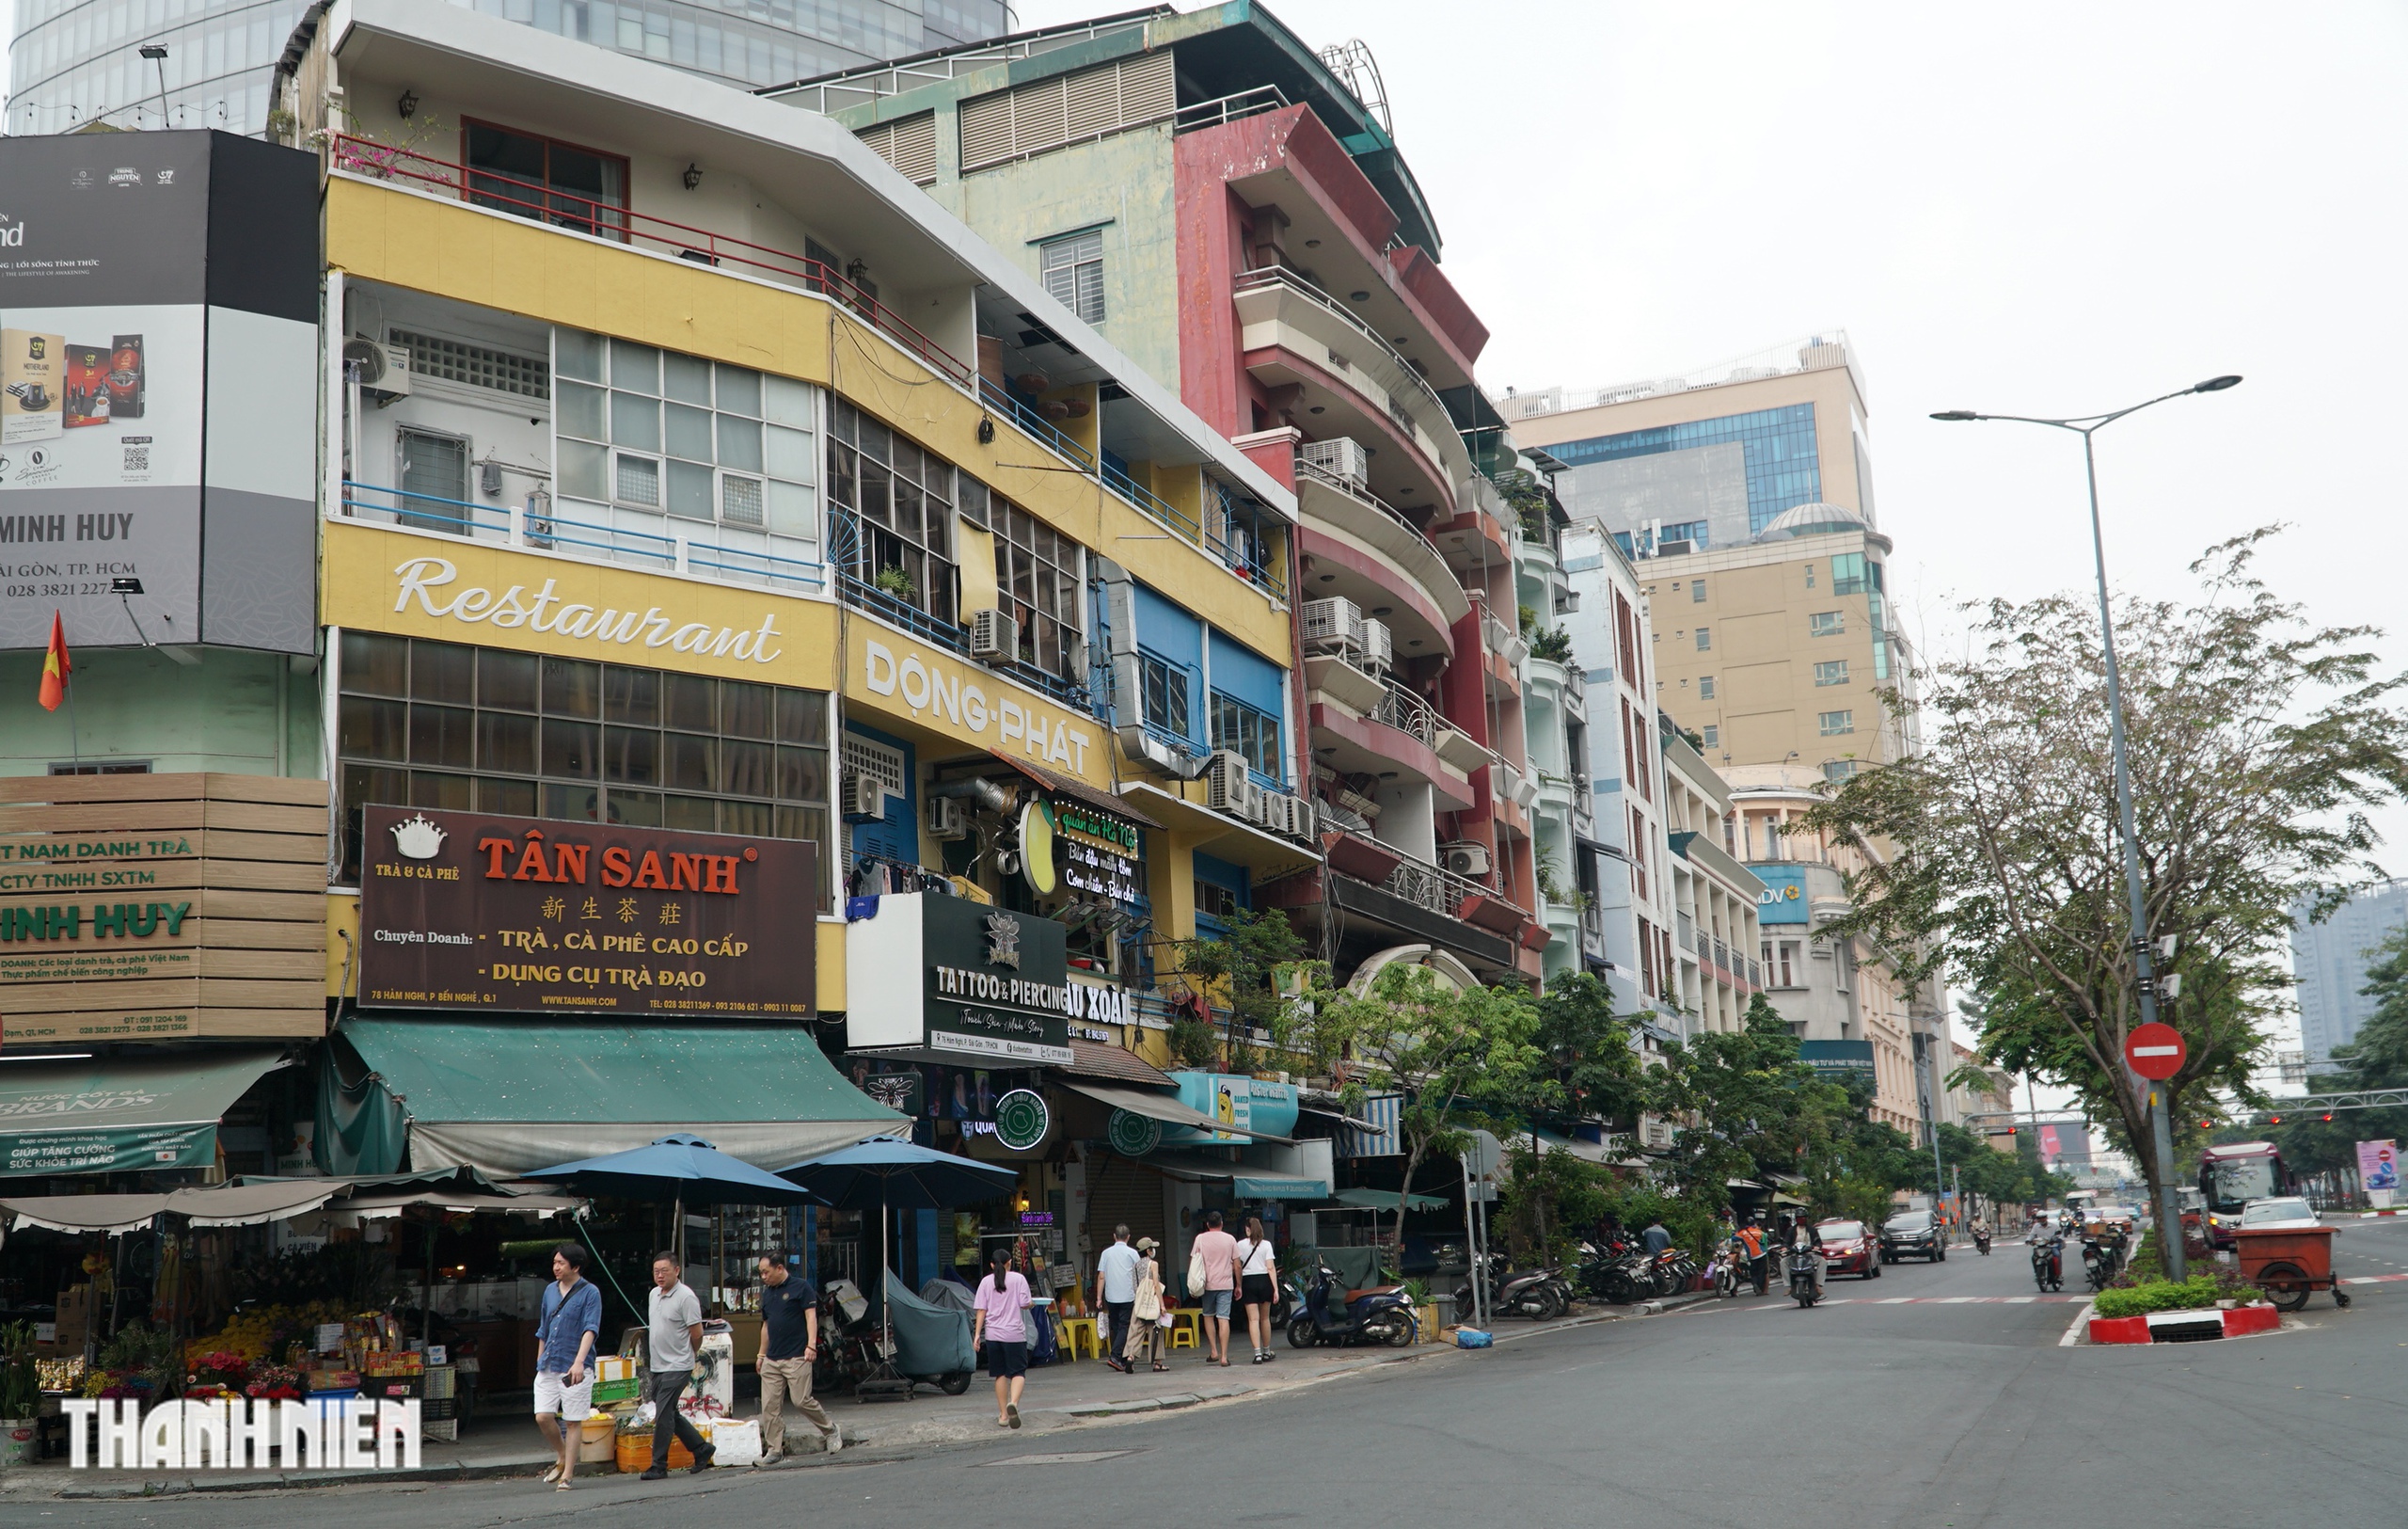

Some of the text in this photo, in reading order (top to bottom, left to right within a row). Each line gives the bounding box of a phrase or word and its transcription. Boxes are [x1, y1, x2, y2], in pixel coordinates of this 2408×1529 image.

[76, 513, 134, 540] HUY
[18, 562, 136, 577] GÒN, TP. HCM
[8, 583, 74, 597] 028 3821
[393, 556, 784, 664] Restaurant
[20, 836, 193, 858] NAM DANH TRÀ
[478, 829, 740, 894] TÂN SANH
[0, 870, 155, 889] CTY TNHH SXTM
[375, 862, 460, 881] TRÀ & CÀ PHÊ
[540, 895, 681, 926] 新生茶莊
[95, 902, 192, 938] HUY
[374, 927, 749, 957] Chuyên Doanh: TRÀ CÀ PHÊ CAO CẤP
[1, 960, 37, 968] DOANH:
[39, 959, 55, 967] Các
[56, 958, 72, 968] loại
[74, 957, 97, 966] danh
[116, 956, 127, 964] cà
[129, 955, 147, 965] phê
[149, 953, 167, 964] Việt
[169, 954, 190, 963] Nam
[2, 966, 149, 980] Thực phẩm chế biến công nghiệp
[492, 963, 705, 991] DỤNG CỤ TRÀ ĐẠO
[372, 988, 497, 1003] 78 HÀM NGHI, P BẾN NGHÉ Q.1
[937, 966, 1068, 1011] TATTOO & PIERCING
[542, 995, 617, 1007] WWW.TANSANH.COM
[650, 999, 806, 1013] TEL: 028 38211369 093 2106 621 0903 11 0087
[1086, 984, 1128, 1025] XOÀI
[19, 1093, 72, 1102] NƯỚC
[1234, 1095, 1249, 1104] BAKED
[19, 1137, 36, 1145] Được
[38, 1137, 57, 1145] chứng
[95, 1135, 107, 1143] học
[11, 1142, 116, 1157] GIÚP TĂNG CƯỜNG
[9, 1155, 115, 1169] SỨC KHỎE TRÍ NÃO
